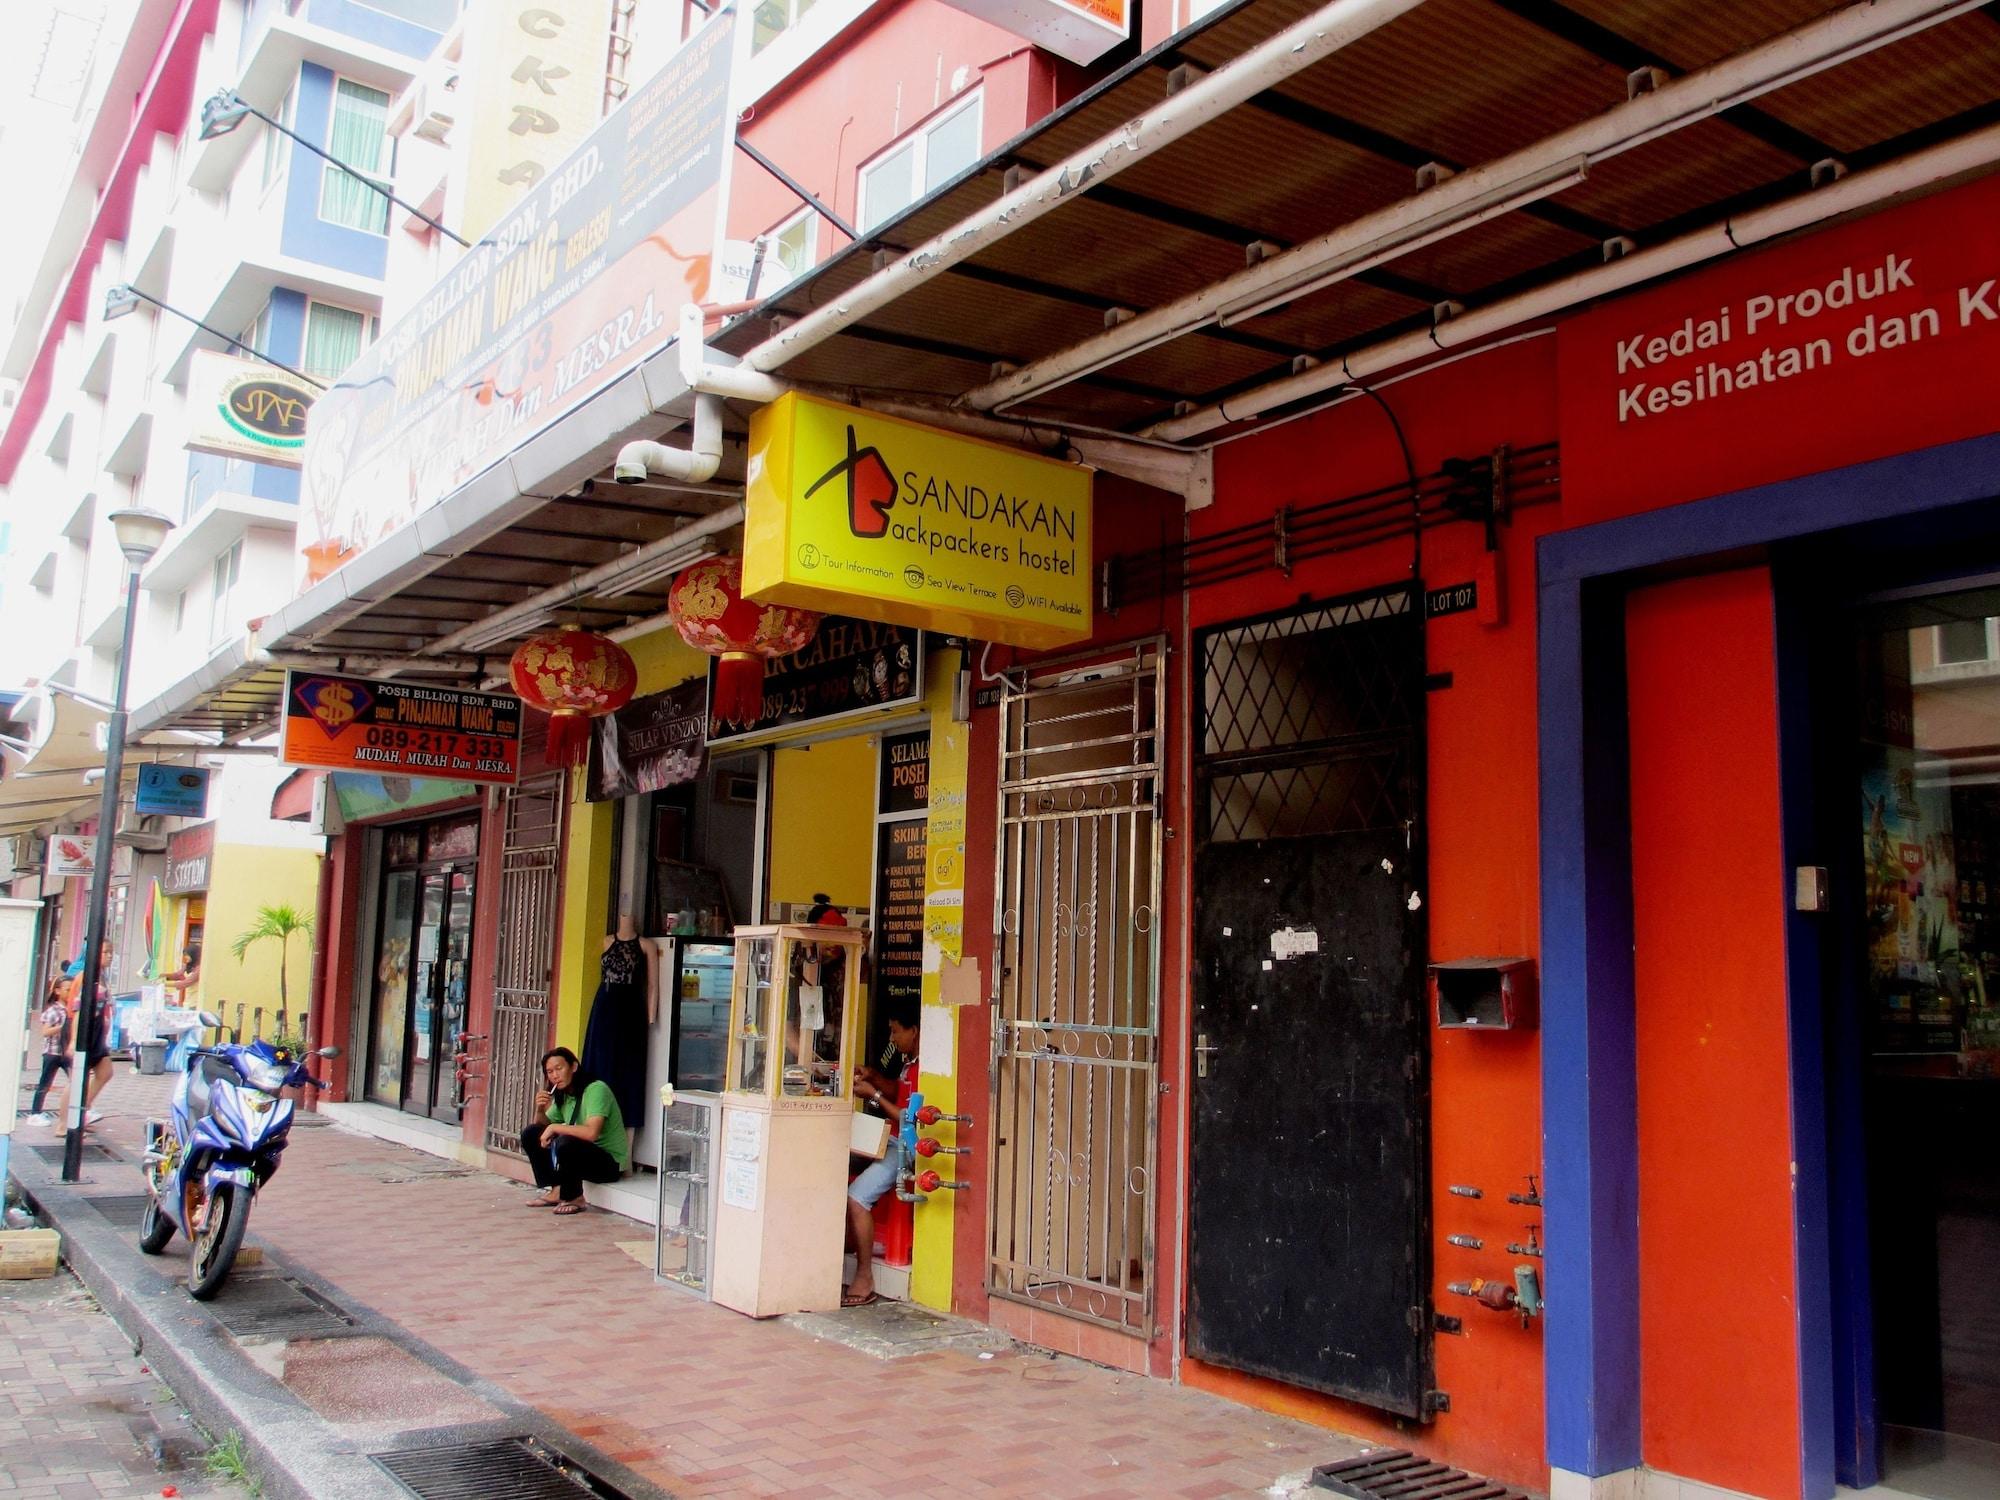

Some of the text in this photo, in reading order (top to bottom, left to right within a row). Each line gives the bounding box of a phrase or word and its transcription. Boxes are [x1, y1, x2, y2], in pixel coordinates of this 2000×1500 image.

[547, 145, 604, 218] BHD.
[492, 219, 558, 334] WANG
[1615, 254, 1915, 375] Kedai Produk
[552, 288, 664, 402] MESRA.
[1616, 279, 2000, 423] Kesihatan dan K
[902, 471, 1076, 543] SANDAKAN
[822, 555, 894, 580] Tour Information
[1018, 538, 1076, 577] hostel
[927, 575, 998, 599] Sea View Terrace
[1432, 588, 1471, 612] LOT 107
[1050, 602, 1083, 616] Available
[377, 685, 518, 711] POSH BILLION SDN. BHD.
[398, 698, 456, 728] PINJAMAN
[461, 705, 494, 731] WANG
[366, 727, 505, 759] 089-217 333
[355, 747, 402, 765] MUDAH,
[406, 752, 448, 768] MURAH
[452, 756, 471, 769] Dan
[475, 760, 513, 774] MESRA.
[893, 762, 926, 787] POSH
[893, 827, 919, 843] SKIM
[1903, 850, 1920, 863] NEW
[937, 865, 950, 877] digi
